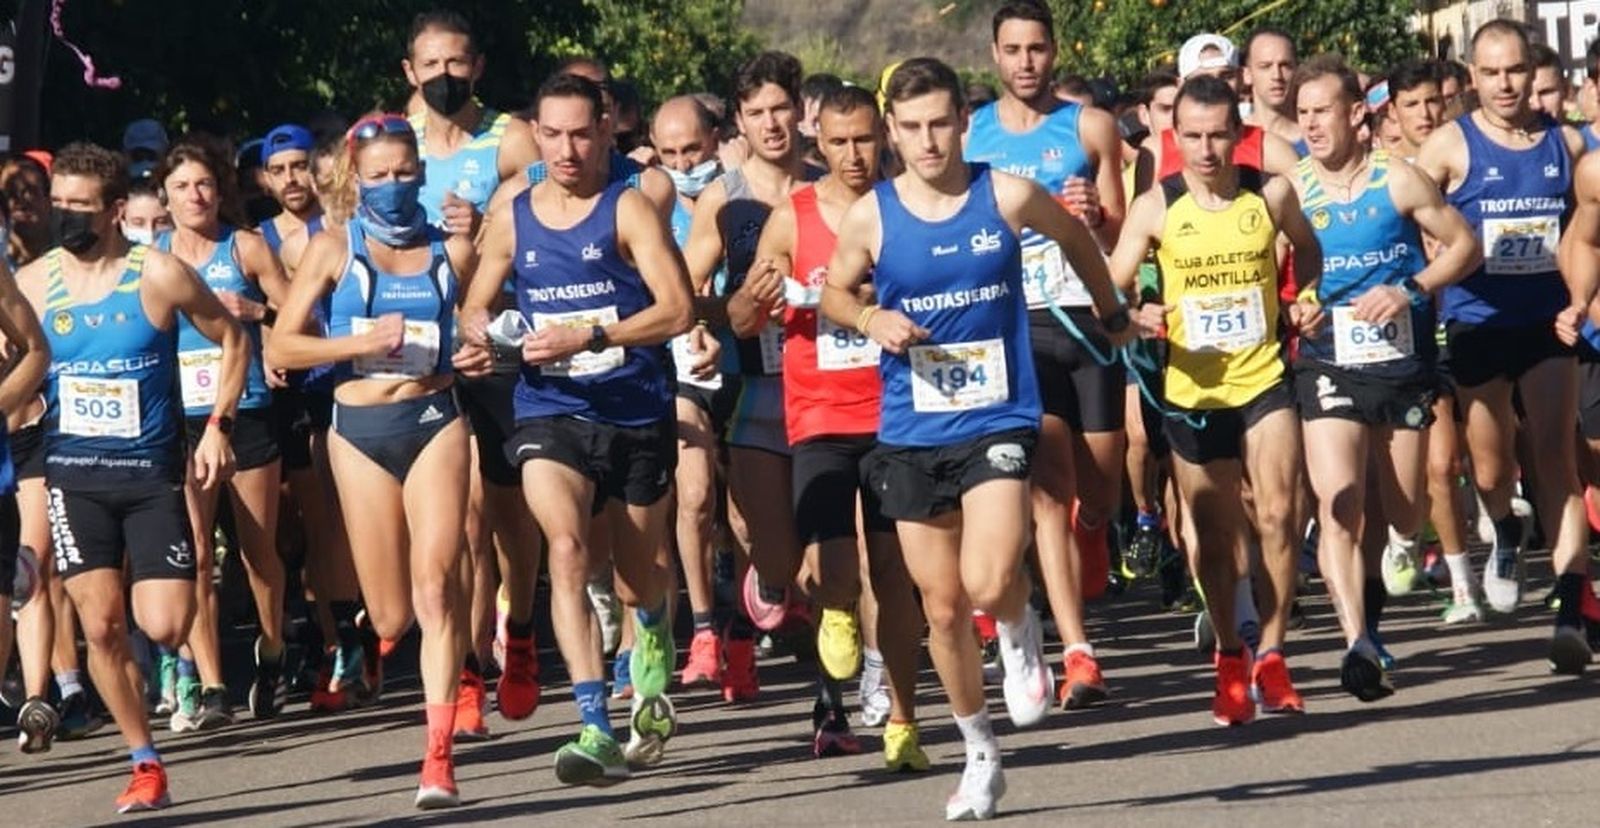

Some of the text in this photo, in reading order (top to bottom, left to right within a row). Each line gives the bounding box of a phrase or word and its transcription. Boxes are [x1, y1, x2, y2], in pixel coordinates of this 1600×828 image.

[1500, 236, 1546, 258] 277
[1174, 256, 1202, 269] CLUB
[1184, 269, 1260, 289] MONTILLA
[527, 279, 616, 302] TROTASIERRA
[900, 281, 1009, 313] TROTASIERRA
[1200, 310, 1247, 334] 751
[1351, 321, 1398, 344] 630
[196, 369, 211, 388] 6
[932, 363, 987, 392] 194
[74, 397, 122, 419] 503
